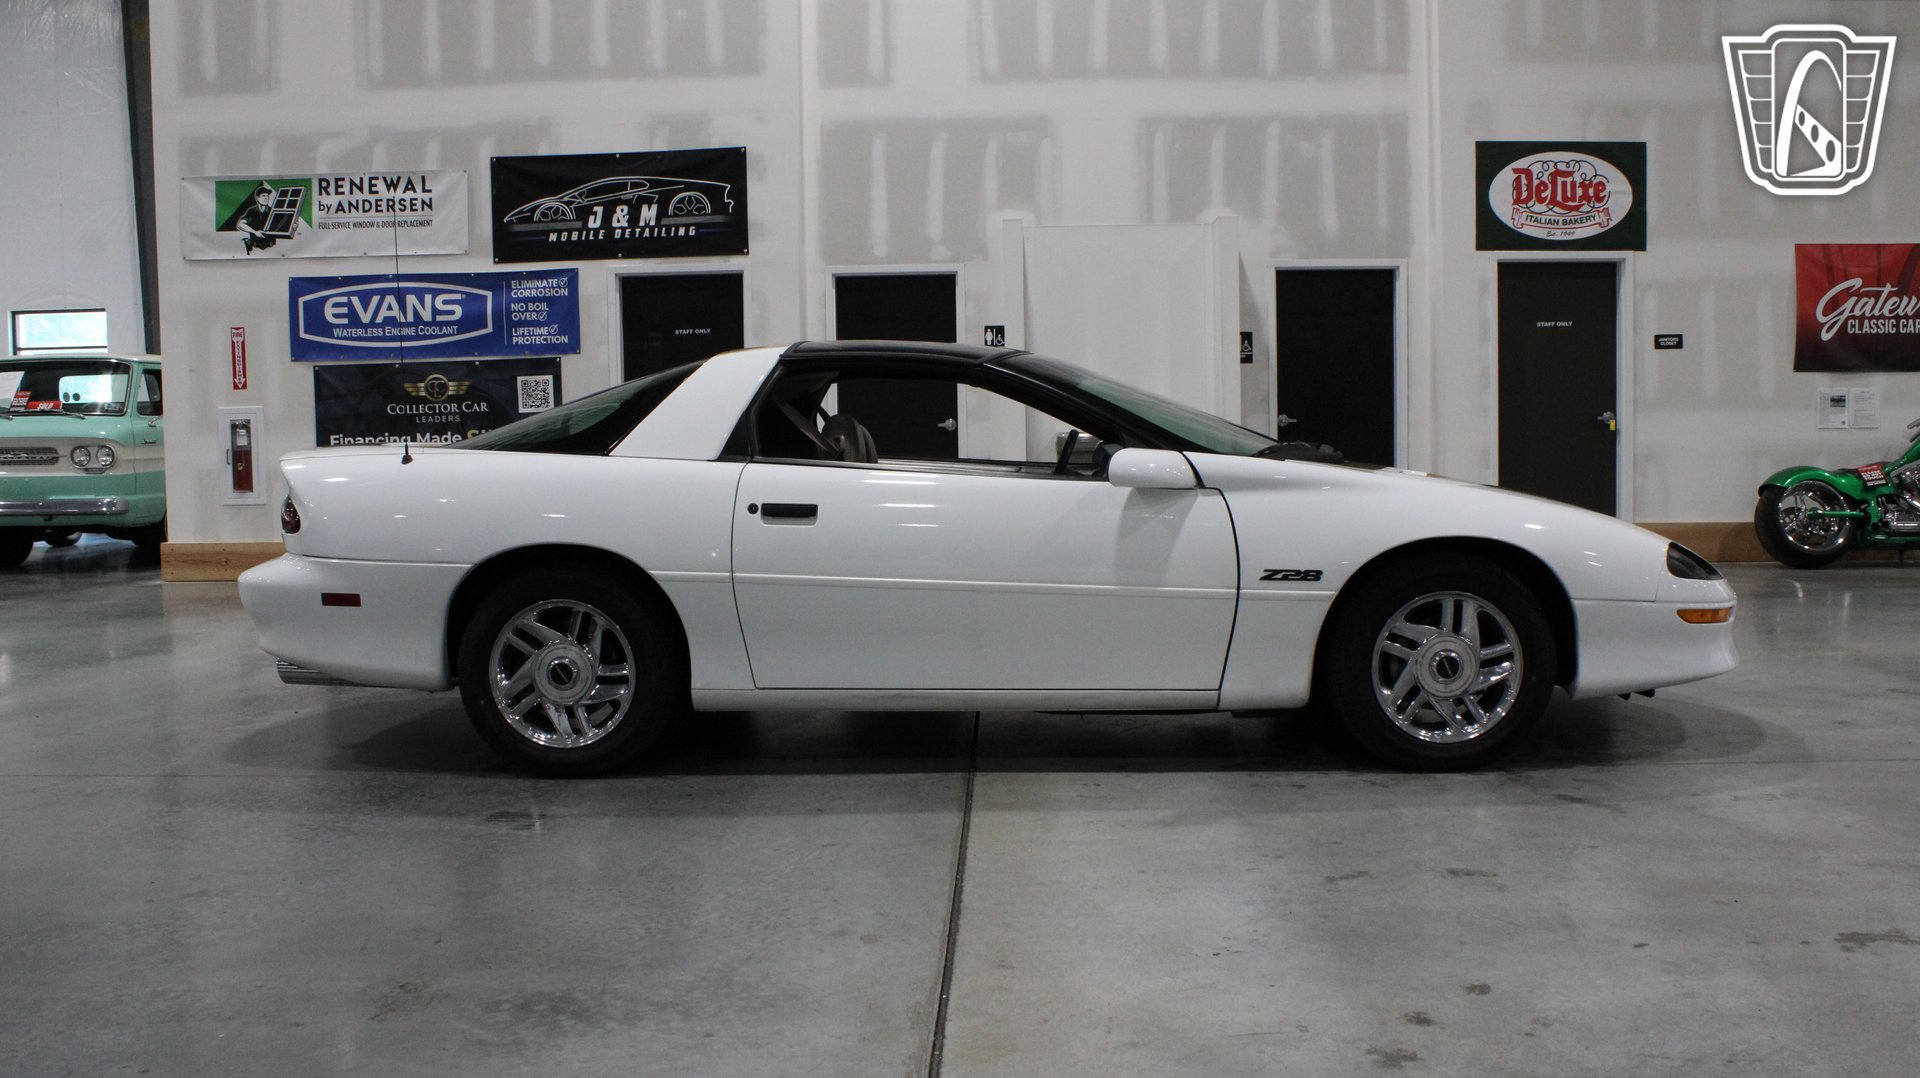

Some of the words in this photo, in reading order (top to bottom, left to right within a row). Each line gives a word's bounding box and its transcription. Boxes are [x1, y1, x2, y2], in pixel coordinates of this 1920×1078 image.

[318, 175, 432, 196] RENEWAL
[1511, 167, 1608, 212] DeLuxe
[318, 200, 332, 214] by
[334, 197, 433, 213] ANDERSEN
[588, 205, 604, 229] J
[612, 204, 630, 228] &
[639, 203, 658, 226] M
[1525, 214, 1560, 226] ITALIAN
[1561, 213, 1596, 226] BAKERY
[352, 221, 375, 229] WINDOW
[381, 220, 396, 229] DOOR
[397, 219, 433, 228] REPLACEMENT
[548, 230, 605, 242] MOBILE
[614, 226, 696, 239] DETAILING
[511, 278, 558, 289] ELIMINATE
[511, 288, 568, 298] CORROSION
[324, 293, 463, 325] EVANS
[511, 302, 526, 311] NO
[528, 302, 549, 311] BOIL
[512, 311, 538, 321] OVER
[333, 327, 383, 338] WATERLESS
[385, 326, 417, 336] ENGINE
[418, 325, 458, 335] COOLANT
[512, 326, 549, 336] LIFETIME
[1847, 319, 1897, 334] CLASSIC
[512, 335, 568, 345] PROTECTION
[387, 403, 459, 415] COLLECTOR
[462, 401, 488, 413] CAR
[416, 414, 461, 423] LEADERS
[416, 431, 462, 444] Made
[1259, 568, 1323, 582] Z28
